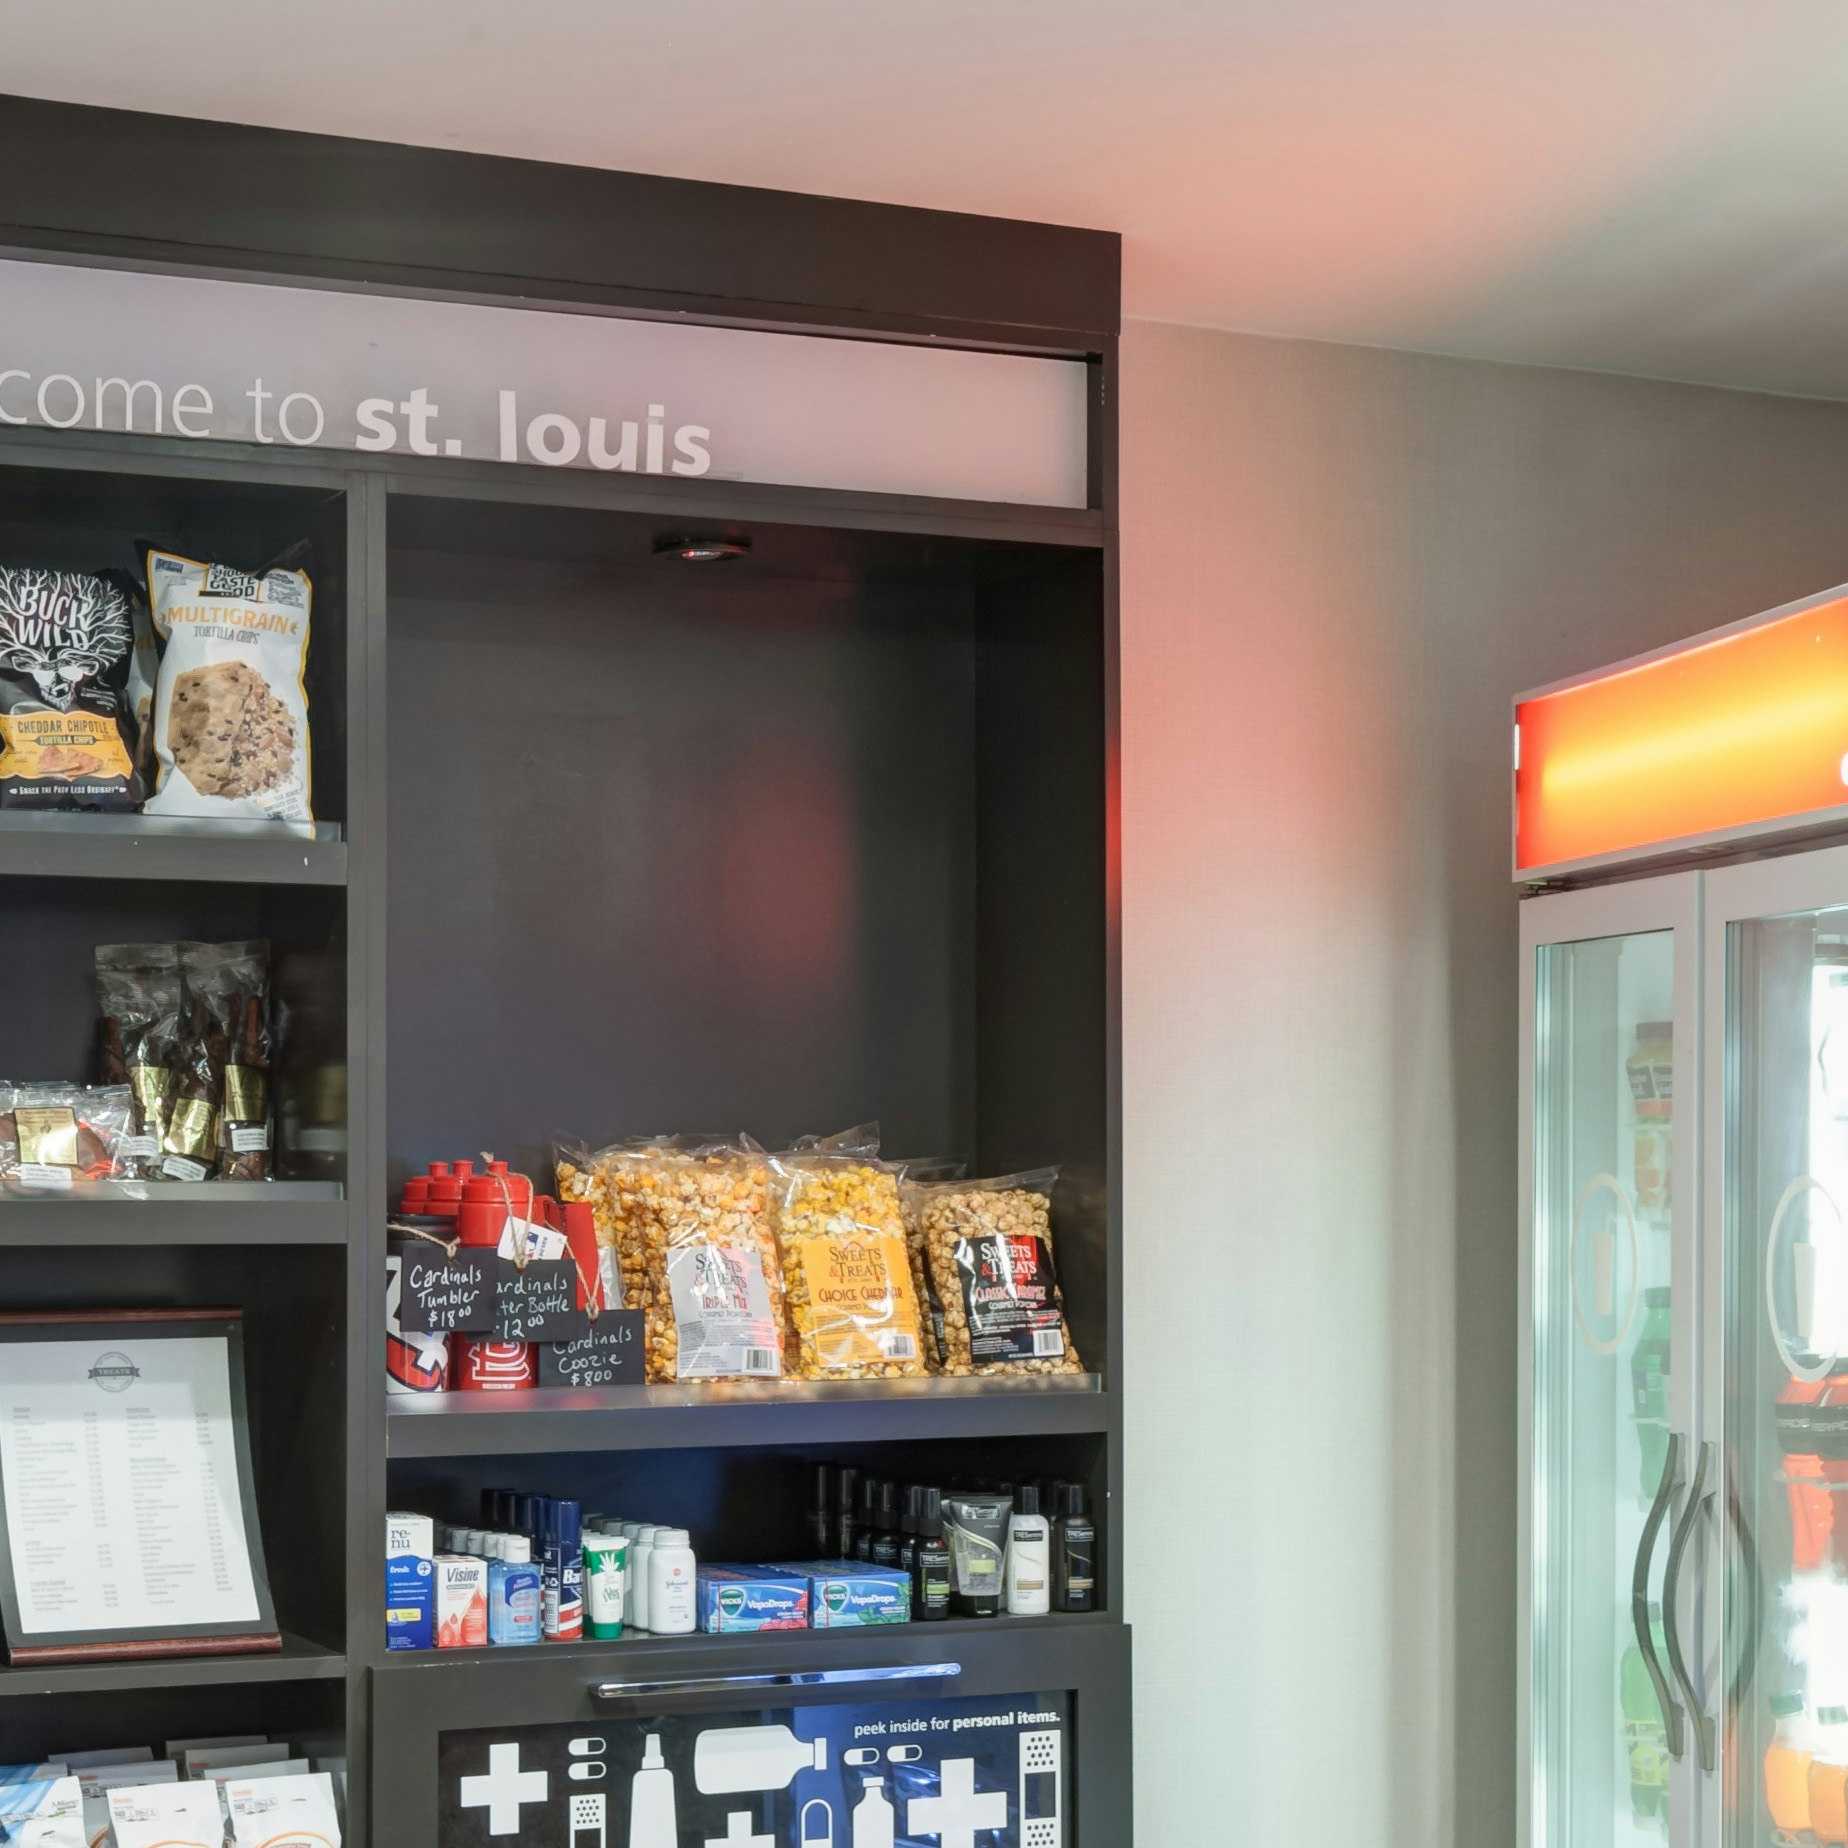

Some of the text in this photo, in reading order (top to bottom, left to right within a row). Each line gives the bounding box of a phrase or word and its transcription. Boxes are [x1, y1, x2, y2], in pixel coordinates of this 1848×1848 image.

[246, 378, 325, 446] to
[355, 388, 462, 458] st.
[499, 389, 712, 478] louis
[210, 576, 256, 588] TASTE
[20, 586, 91, 630] BUCK
[168, 607, 290, 633] MULTIGRAIN
[17, 616, 89, 651] WILD
[193, 625, 234, 641] TORTILLA
[17, 720, 109, 734] CHEDDAR CHIPOTLE
[829, 1247, 881, 1262] SWEETS
[410, 1264, 482, 1290] Cardinals
[837, 1261, 886, 1279] TREATS
[417, 1289, 480, 1308] Tumbler
[819, 1288, 858, 1302] CHOICE
[528, 1296, 569, 1314] Bottle
[558, 1354, 622, 1374] Coozie
[391, 1539, 410, 1550] nu
[390, 1565, 410, 1574] fresh
[446, 1567, 480, 1582] Visine
[747, 1599, 794, 1610] VapoDrops
[851, 1594, 897, 1606] VapoDrops
[854, 1711, 1061, 1738] peek inside for personal items.
